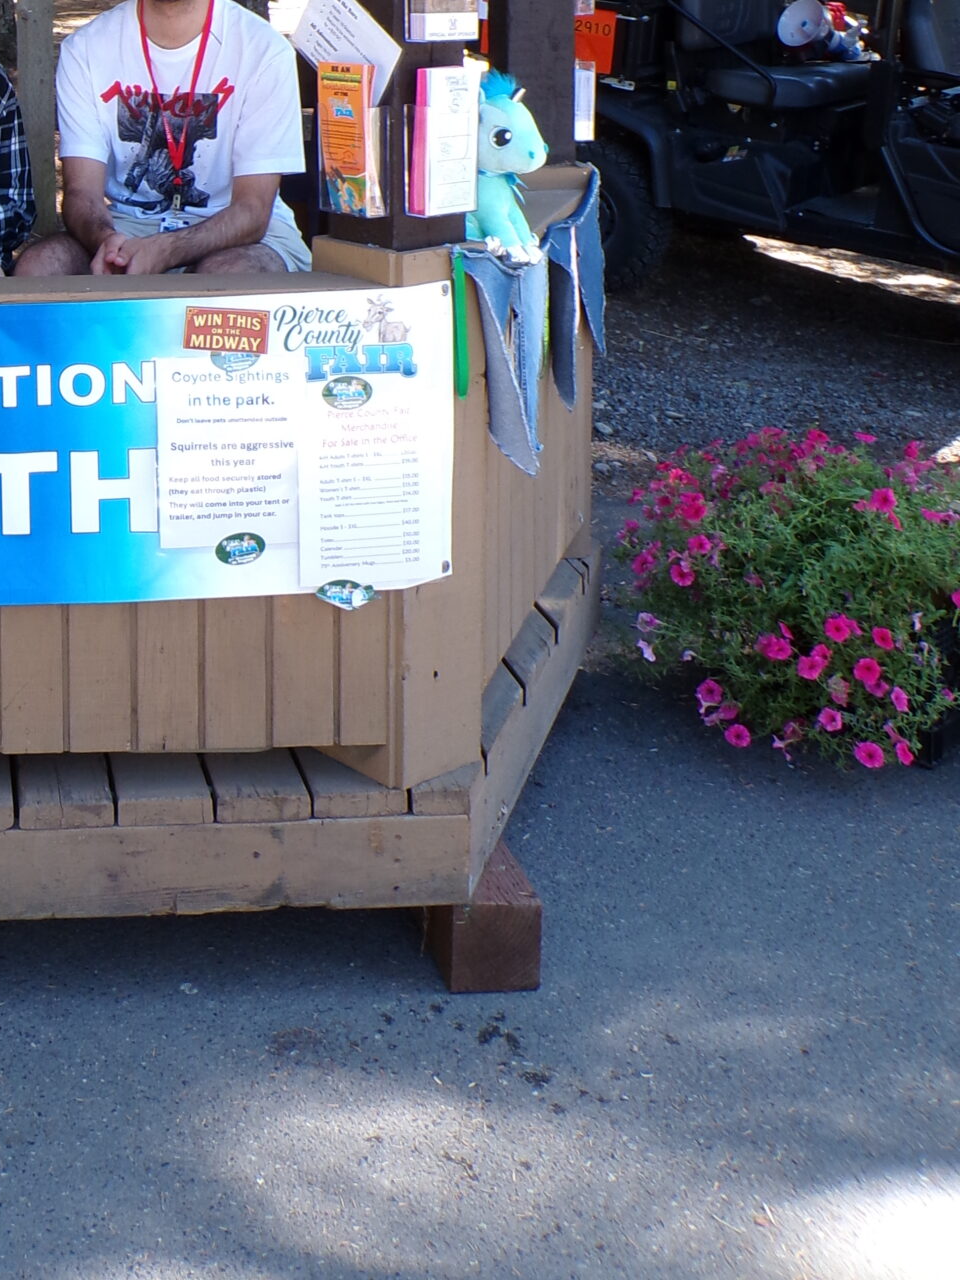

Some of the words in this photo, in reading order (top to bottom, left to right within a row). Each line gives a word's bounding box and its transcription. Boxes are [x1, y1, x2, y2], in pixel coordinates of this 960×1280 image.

[192, 313, 223, 328] WIN
[226, 314, 262, 331] THIS
[274, 304, 347, 332] Pierce
[283, 320, 362, 352] County
[189, 334, 262, 352] MIDWAY
[305, 343, 418, 382] FAIR
[171, 371, 222, 384] Coyote
[225, 370, 290, 384] Sightings
[188, 394, 202, 406] in
[206, 394, 231, 406] the
[236, 393, 275, 408] park.
[170, 441, 218, 452] Squirrels
[220, 443, 238, 451] are
[239, 440, 294, 452] aggressive
[322, 439, 338, 448] For
[341, 437, 359, 447] Sale
[211, 458, 230, 467] this
[233, 459, 255, 468] year
[222, 475, 255, 483] securely
[257, 473, 282, 481] stored
[168, 488, 188, 496] (they
[205, 487, 235, 495] through
[237, 485, 266, 494] plastic)
[169, 501, 188, 509] They
[189, 500, 203, 508] will
[229, 499, 244, 507] into
[245, 500, 262, 508] your
[169, 513, 195, 521] trailer,
[196, 512, 212, 520] and
[213, 512, 233, 521] jump
[244, 511, 261, 519] your
